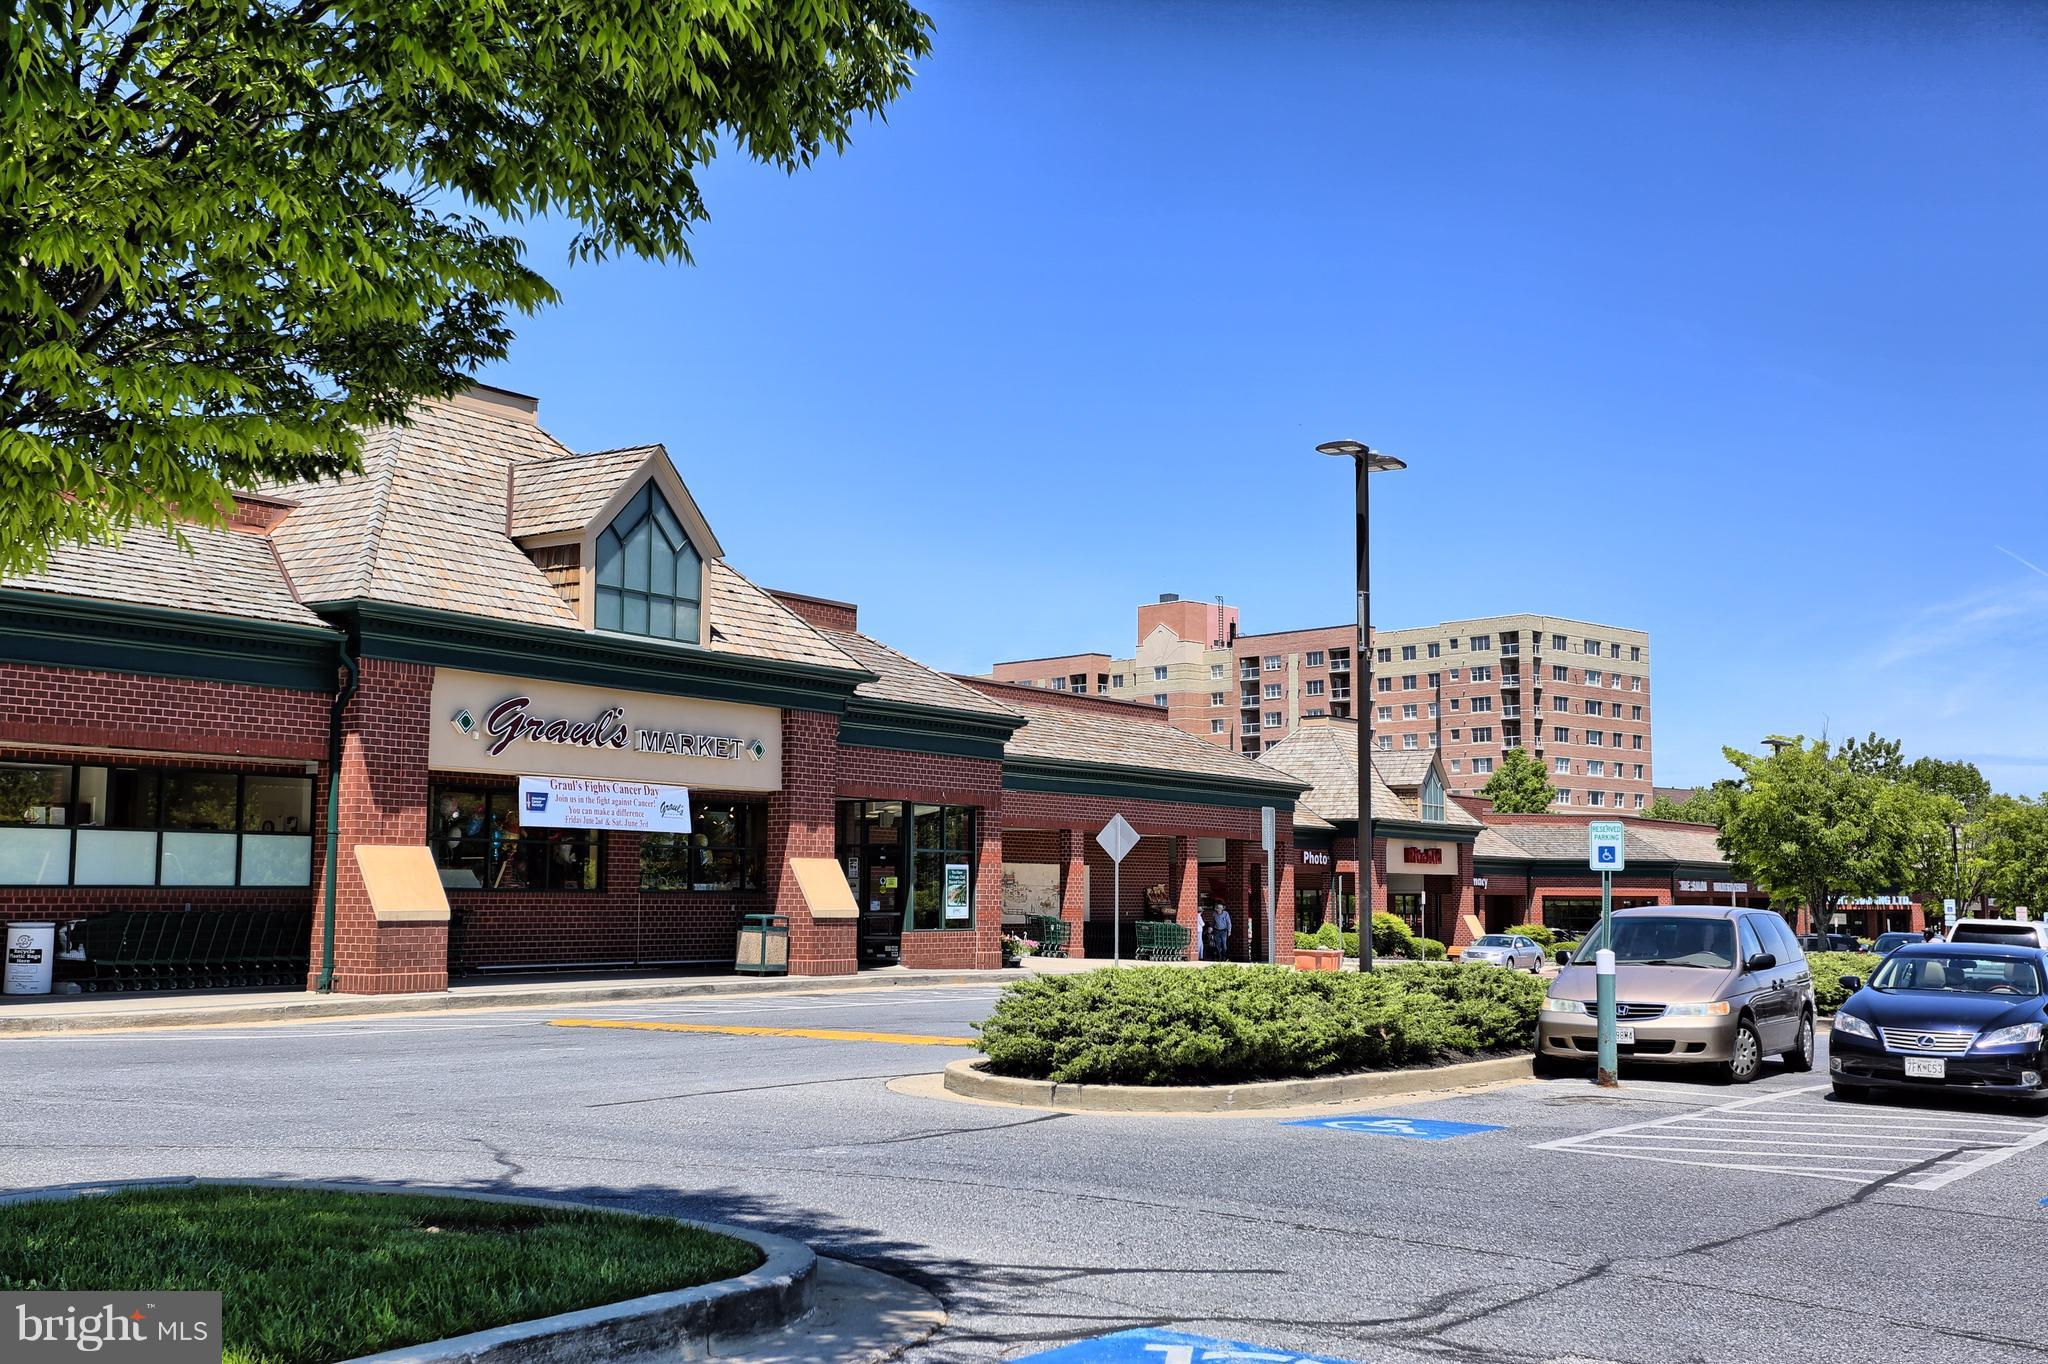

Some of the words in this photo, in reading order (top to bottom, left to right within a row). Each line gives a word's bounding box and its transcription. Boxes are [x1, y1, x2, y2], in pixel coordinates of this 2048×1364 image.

[486, 696, 631, 756] Graul's
[634, 729, 744, 760] MARKET
[550, 779, 583, 791] Graul's
[584, 781, 610, 796] Fights
[612, 782, 641, 795] Cancer
[643, 784, 660, 799] Day
[555, 794, 569, 803] Join
[578, 796, 585, 804] in
[585, 796, 595, 805] the
[596, 796, 610, 807] fight
[611, 798, 632, 808] against
[633, 798, 656, 808] Cancer!
[568, 806, 580, 815] You
[594, 808, 610, 816] make
[616, 808, 645, 818] difference
[565, 815, 581, 825] Friday
[1303, 850, 1328, 865] Photo
